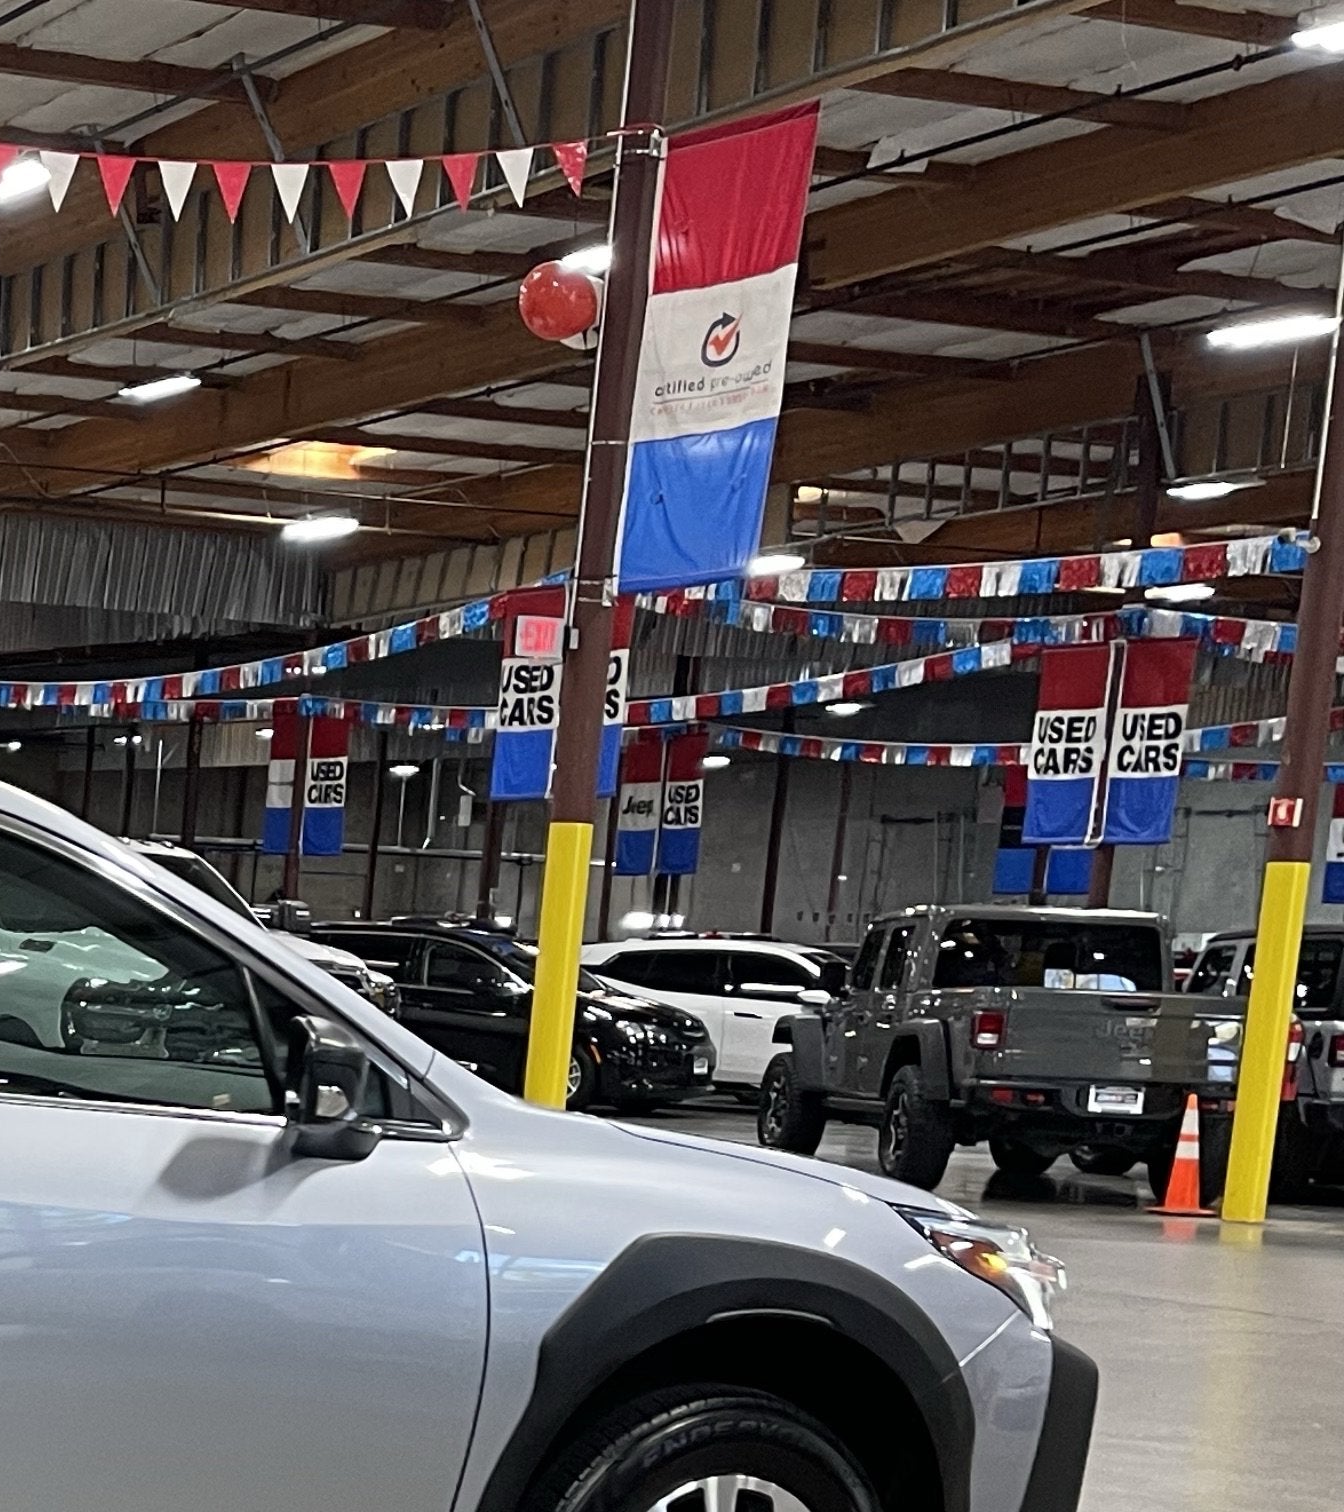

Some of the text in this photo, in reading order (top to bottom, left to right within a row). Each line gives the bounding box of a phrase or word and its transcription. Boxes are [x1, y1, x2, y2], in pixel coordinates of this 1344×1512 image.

[1038, 715, 1097, 744] USED
[311, 761, 344, 782] USED
[1034, 746, 1094, 775] CARS
[1117, 743, 1179, 773] CARS
